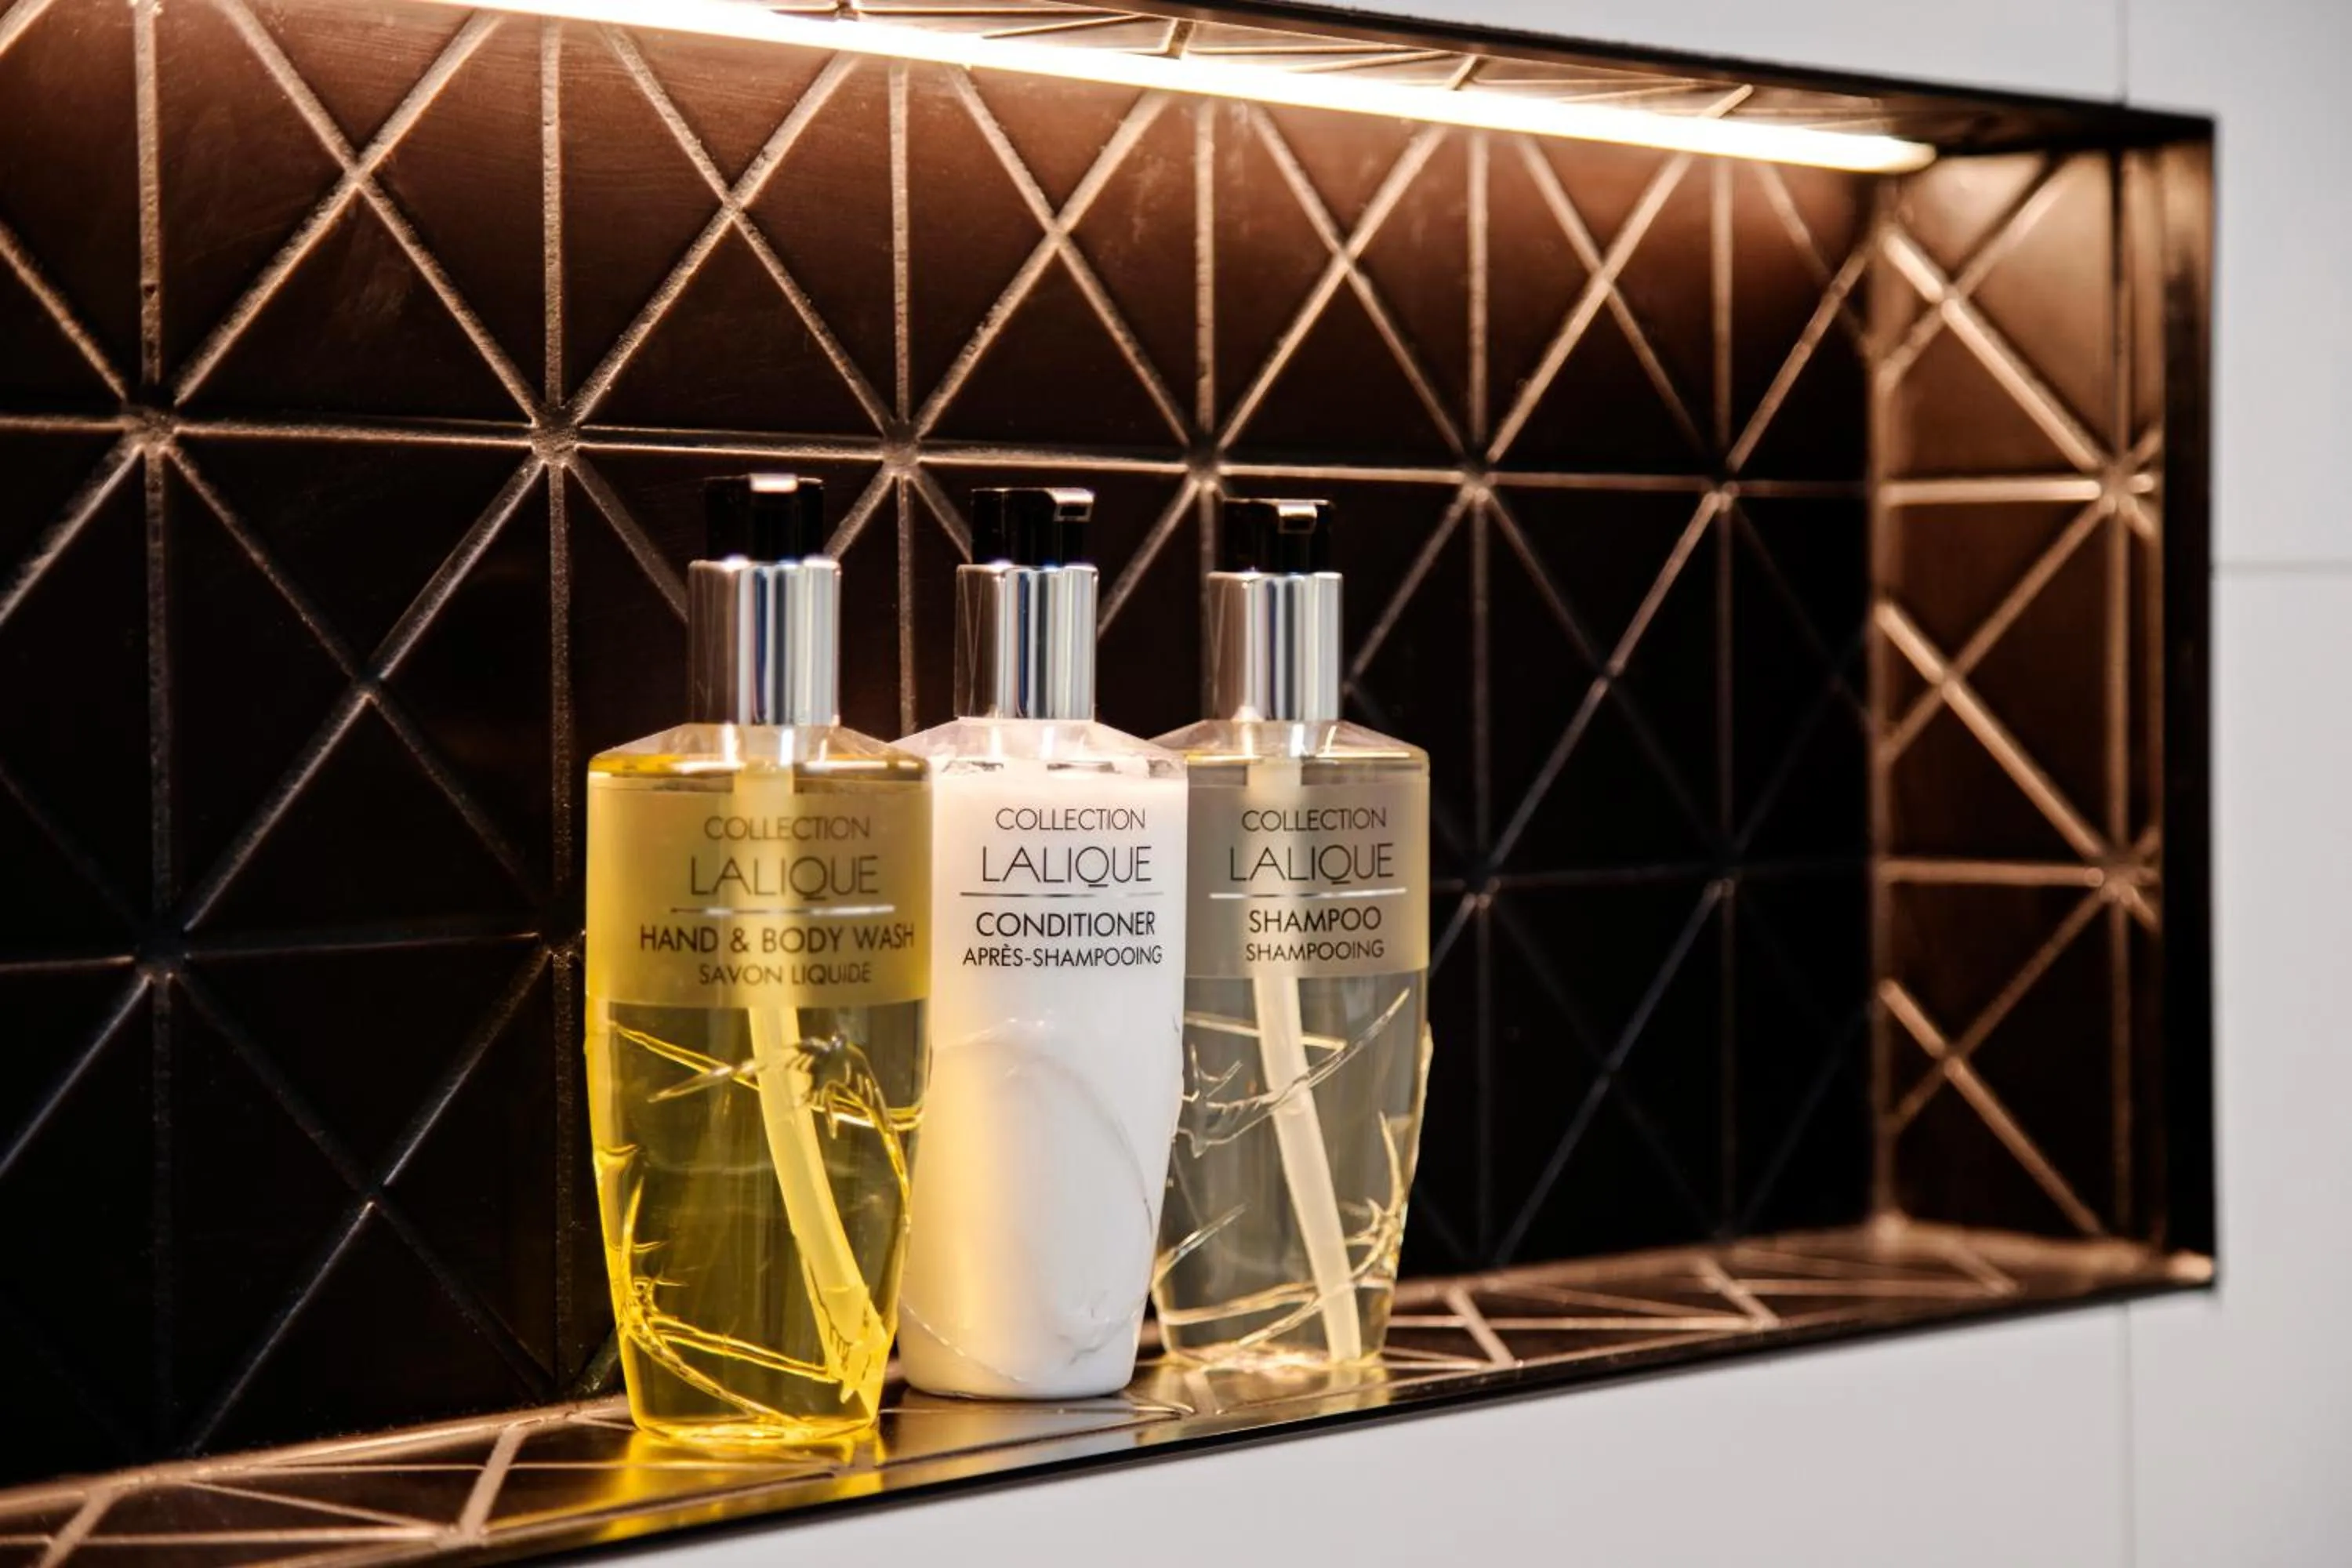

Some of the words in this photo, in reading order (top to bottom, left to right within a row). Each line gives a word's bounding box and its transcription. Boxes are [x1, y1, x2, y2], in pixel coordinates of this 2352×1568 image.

[704, 815, 869, 841] COLLECTION
[996, 808, 1145, 830] COLLECTION
[1241, 807, 1387, 833] COLLECTION
[982, 846, 1152, 887] LALIQUE
[1230, 843, 1394, 885] LALIQUE
[691, 855, 879, 901] LALIQUE
[976, 911, 1155, 937] CONDITIONER
[1249, 906, 1381, 933] SHAMPOO
[641, 924, 718, 953] HAND
[730, 928, 750, 953] &
[762, 927, 844, 953] BODY
[853, 924, 914, 950] WASH
[1246, 939, 1385, 961] SHAMPOOING
[963, 943, 1163, 967] APRÈS-SHAMPOOING
[699, 964, 782, 985] SAVON
[791, 963, 872, 985] LIQUIDE
